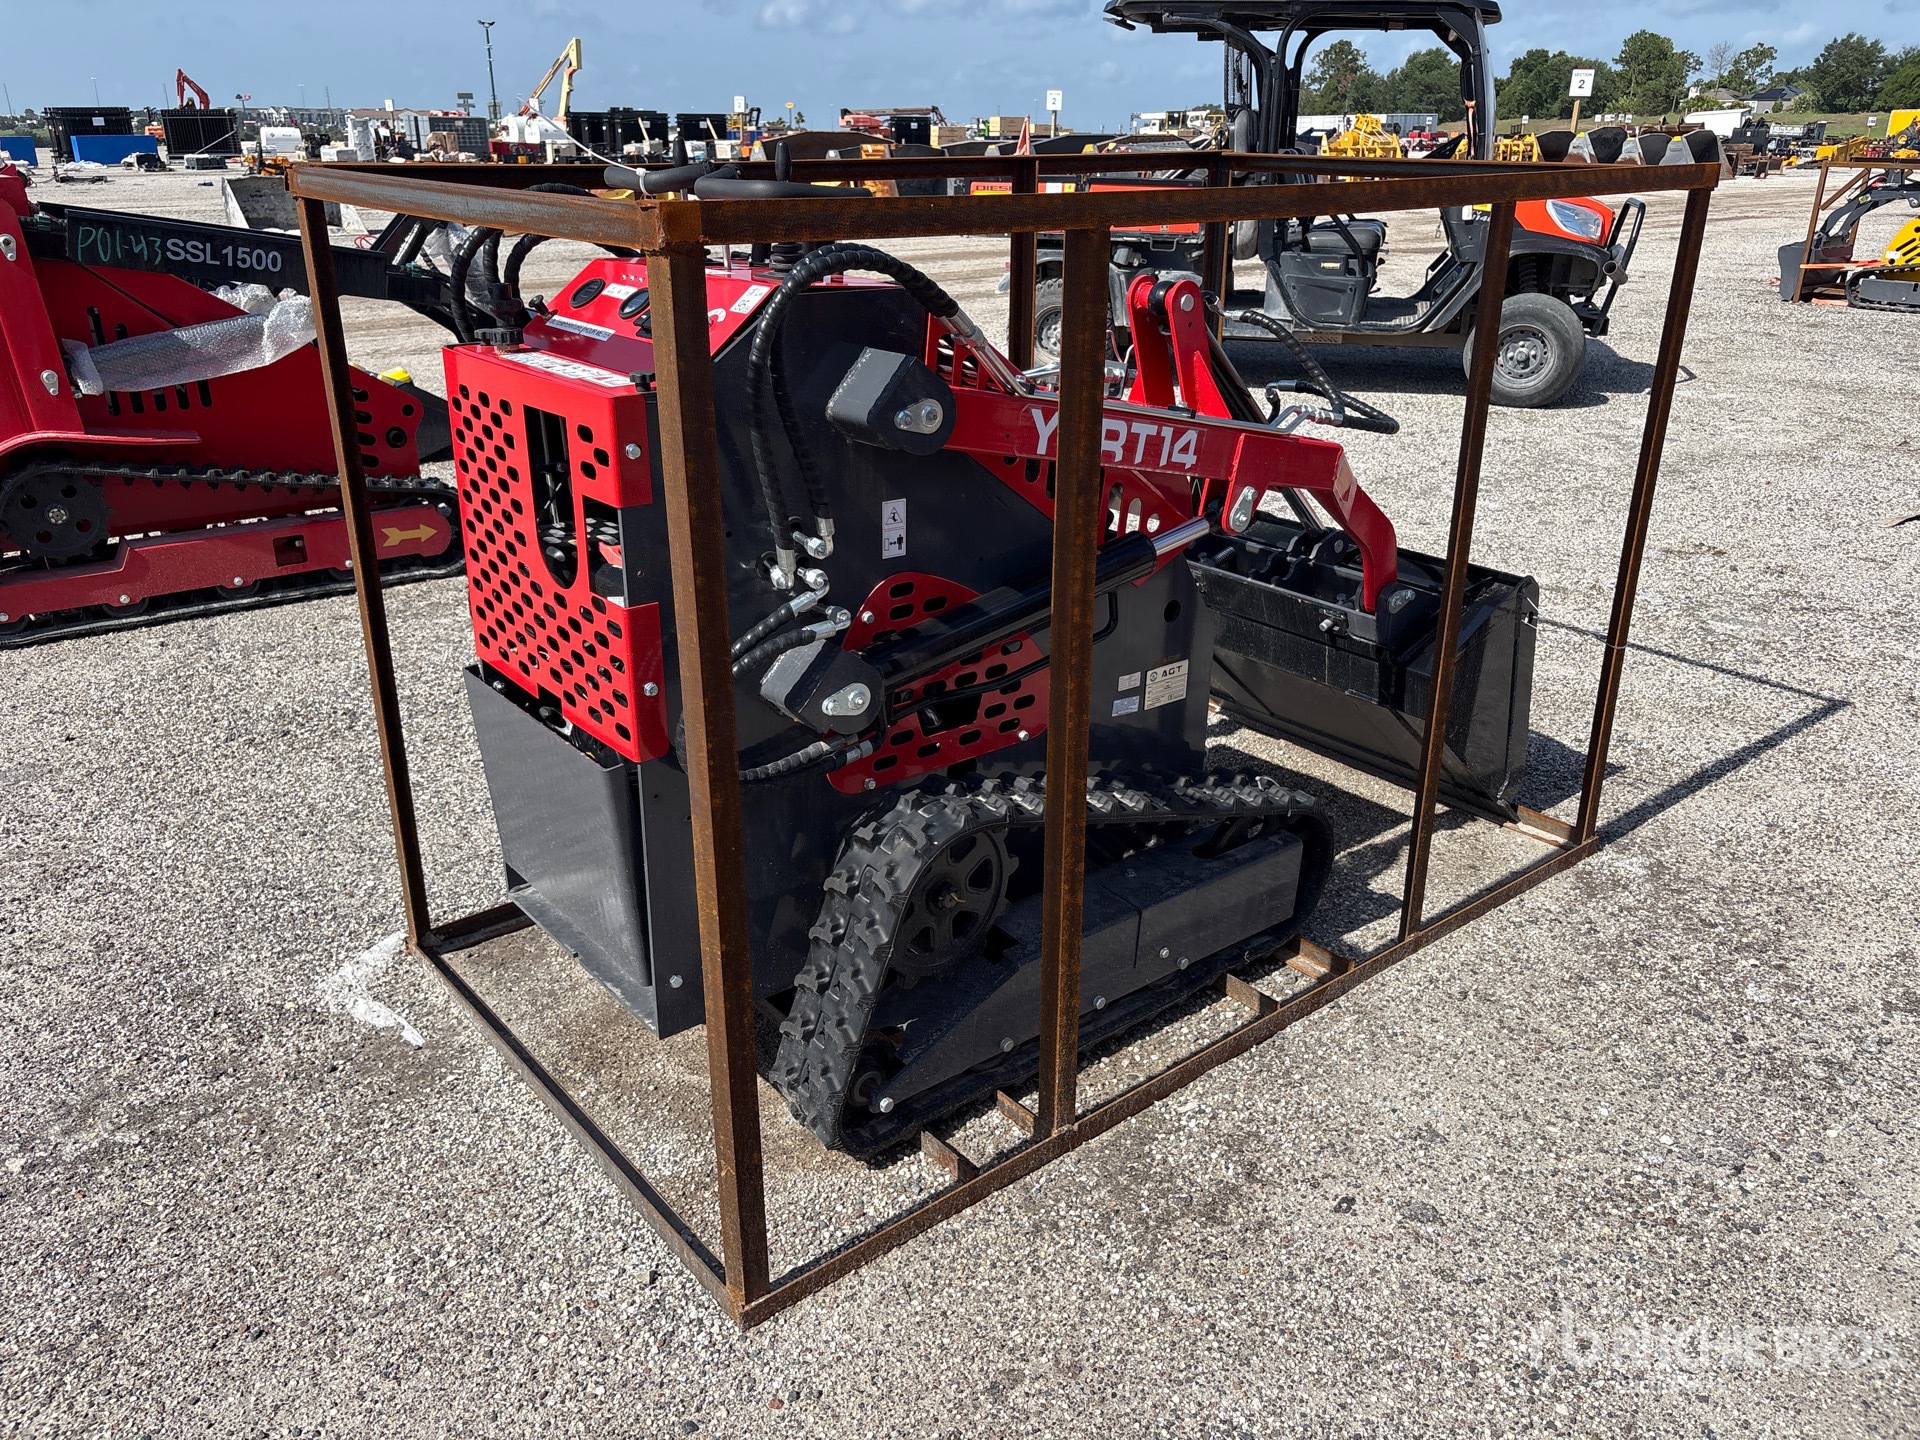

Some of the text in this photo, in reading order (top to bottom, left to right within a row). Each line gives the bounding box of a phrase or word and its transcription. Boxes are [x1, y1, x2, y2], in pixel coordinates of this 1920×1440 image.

[1578, 79, 1585, 89] 2
[1051, 97, 1057, 105] 2
[166, 238, 282, 272] SSL1500
[1031, 408, 1198, 470] YRT14
[1161, 665, 1183, 677] AGT
